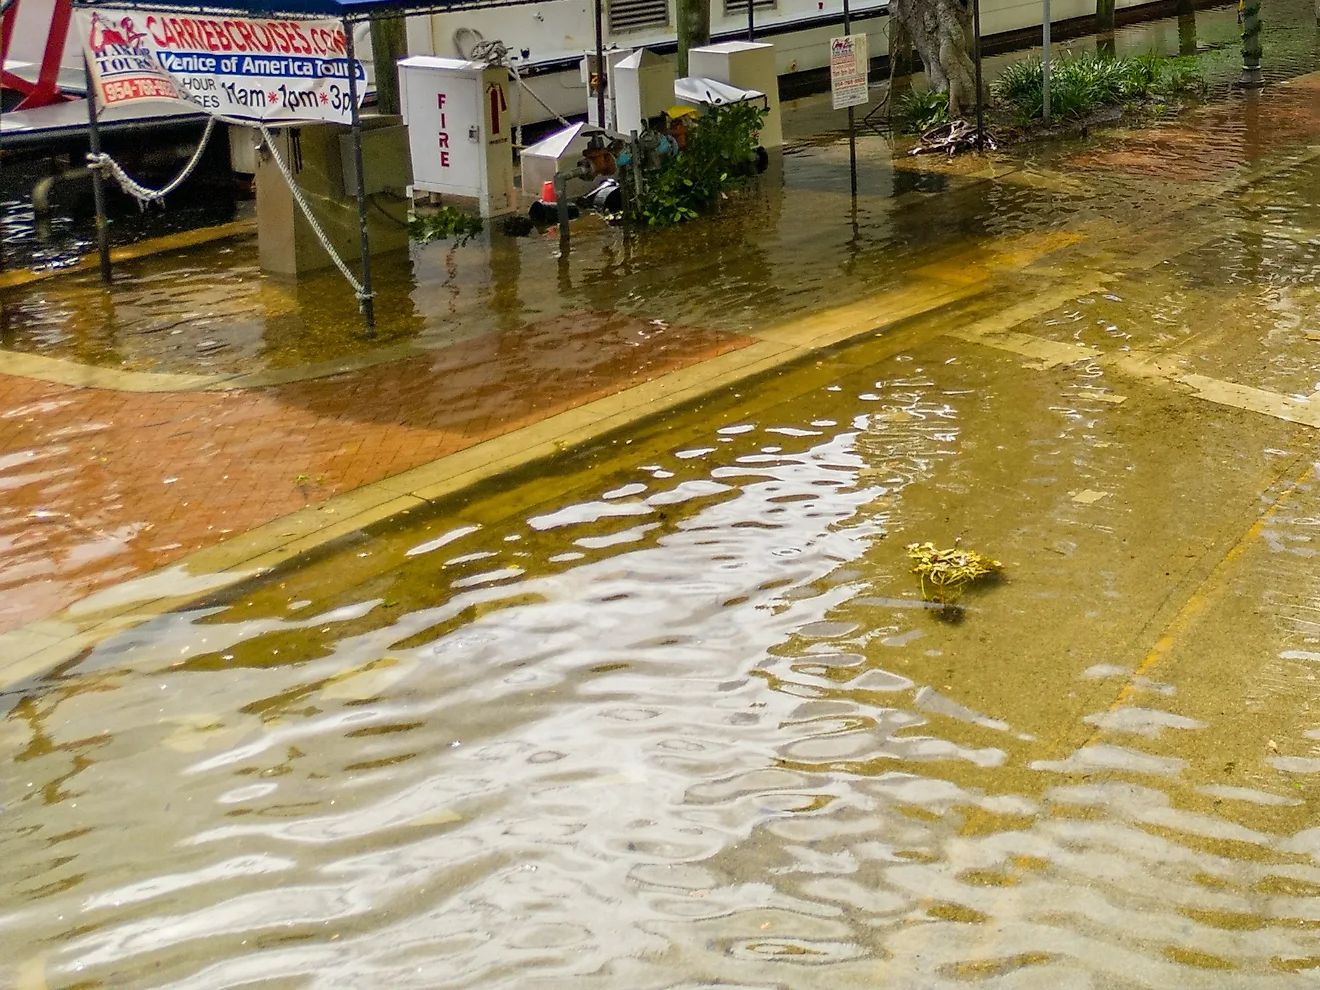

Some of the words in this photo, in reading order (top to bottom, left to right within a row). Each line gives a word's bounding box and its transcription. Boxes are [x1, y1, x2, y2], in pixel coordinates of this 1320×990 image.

[160, 53, 216, 71] Venice
[221, 57, 238, 72] of
[242, 57, 314, 74] America
[182, 77, 217, 91] HOUR
[278, 83, 319, 112] 1pm
[329, 84, 360, 116] 3p
[437, 93, 450, 168] FIRE
